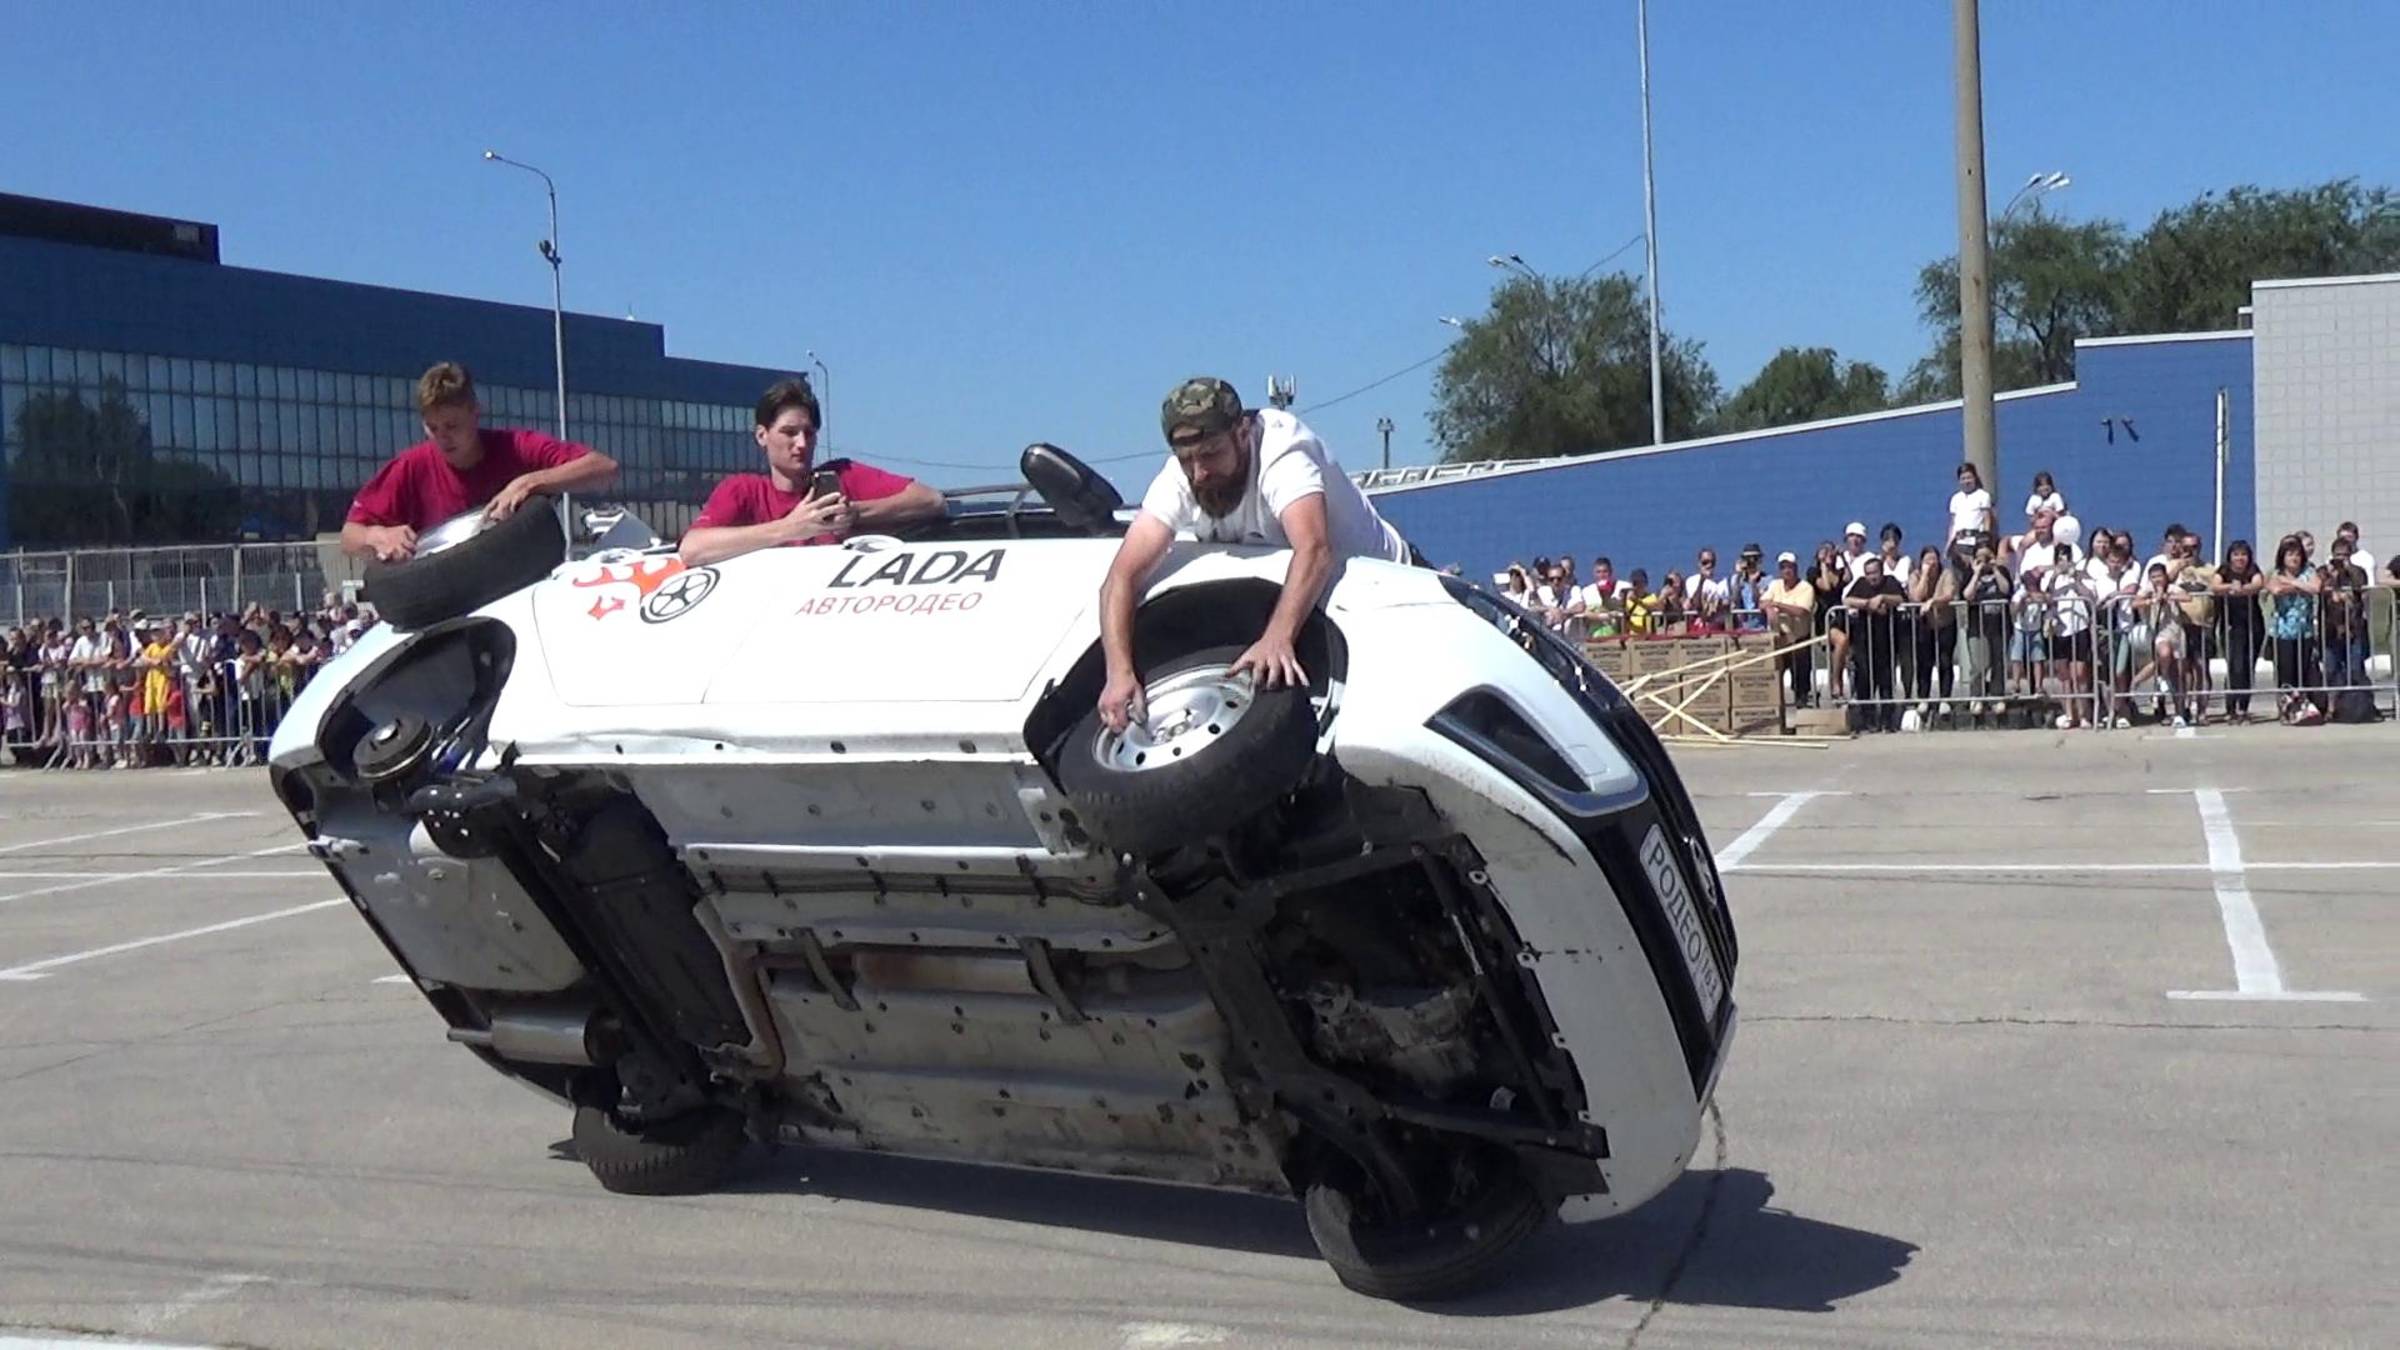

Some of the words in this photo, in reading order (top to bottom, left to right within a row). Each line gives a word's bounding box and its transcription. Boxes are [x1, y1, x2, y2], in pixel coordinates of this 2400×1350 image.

[827, 549, 1007, 588] LADA
[795, 592, 983, 616] АВТОРОДЕО
[1648, 842, 1701, 962] РОДЕО
